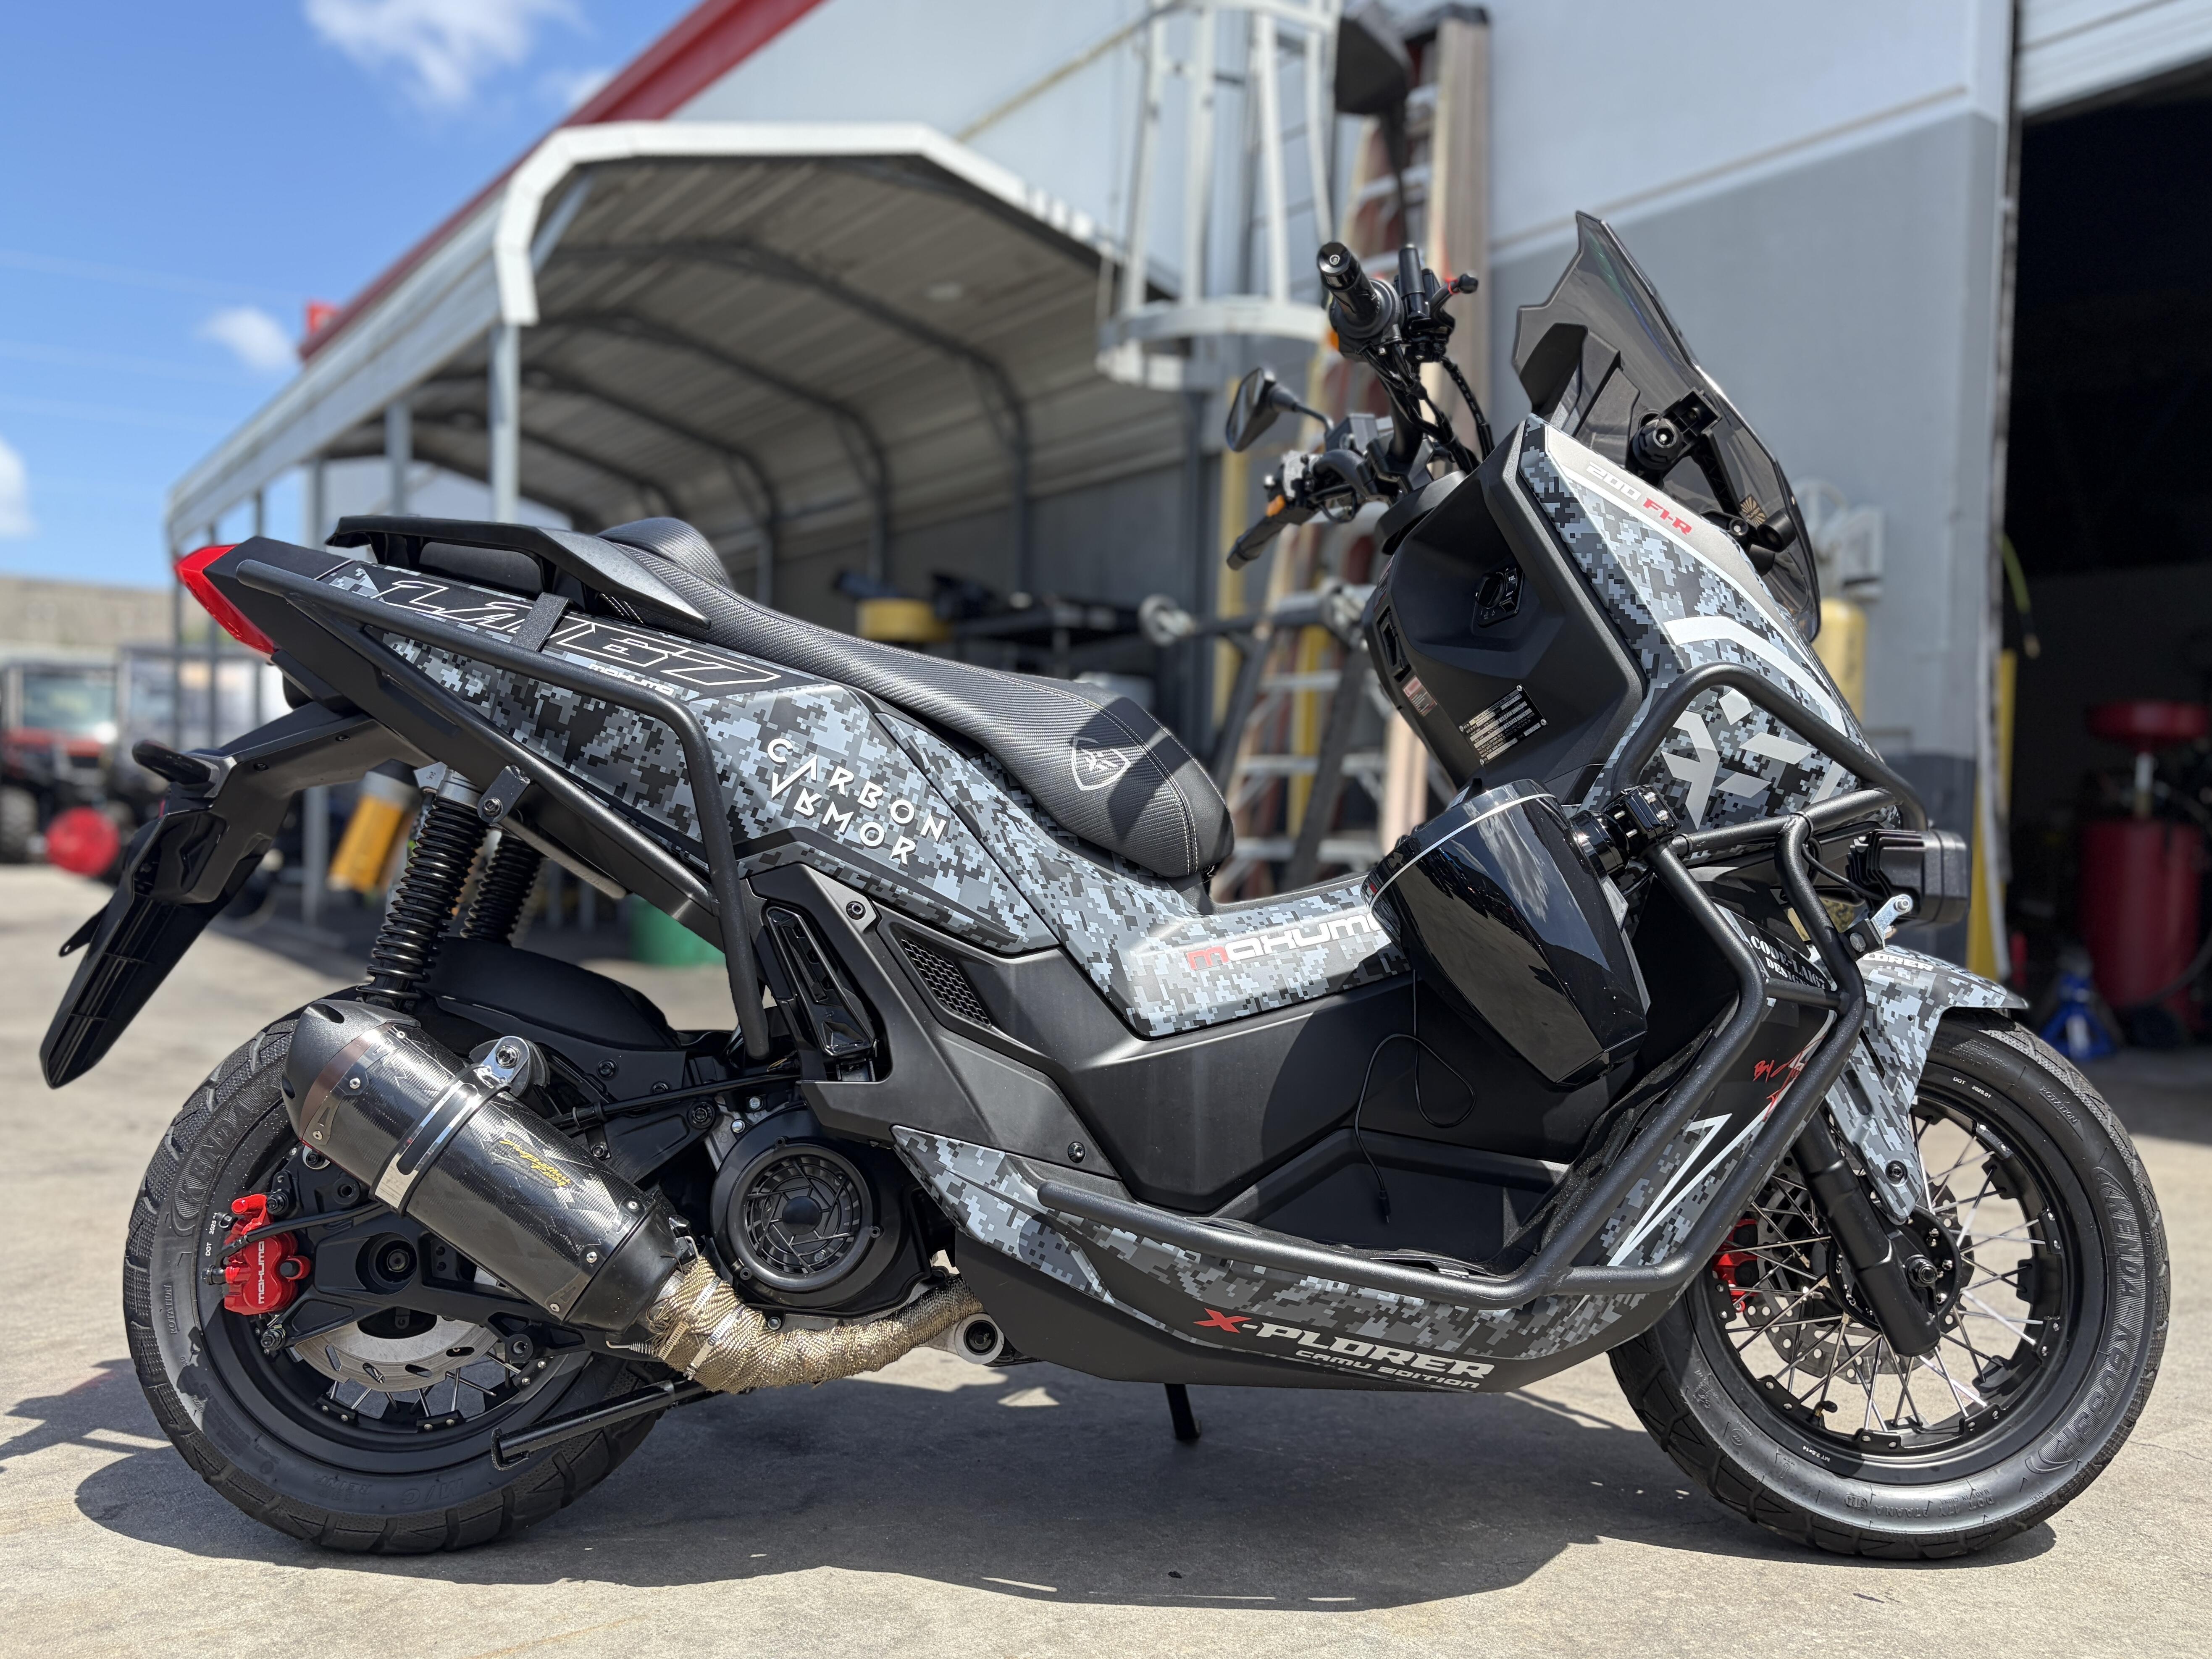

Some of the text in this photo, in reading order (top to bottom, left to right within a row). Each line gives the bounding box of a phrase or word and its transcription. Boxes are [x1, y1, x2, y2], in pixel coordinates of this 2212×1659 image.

[1586, 461, 1642, 501] 200
[767, 738, 947, 843] CARBON
[1953, 1076, 1966, 1085] DOT
[2105, 1195, 2141, 1297] KENDA
[1193, 1307, 1495, 1380] X-PLORER
[1377, 1365, 1480, 1389] EDITION
[401, 1478, 463, 1504] M/C
[1940, 1496, 1960, 1505] CHINA
[1969, 1494, 1995, 1512] DOT
